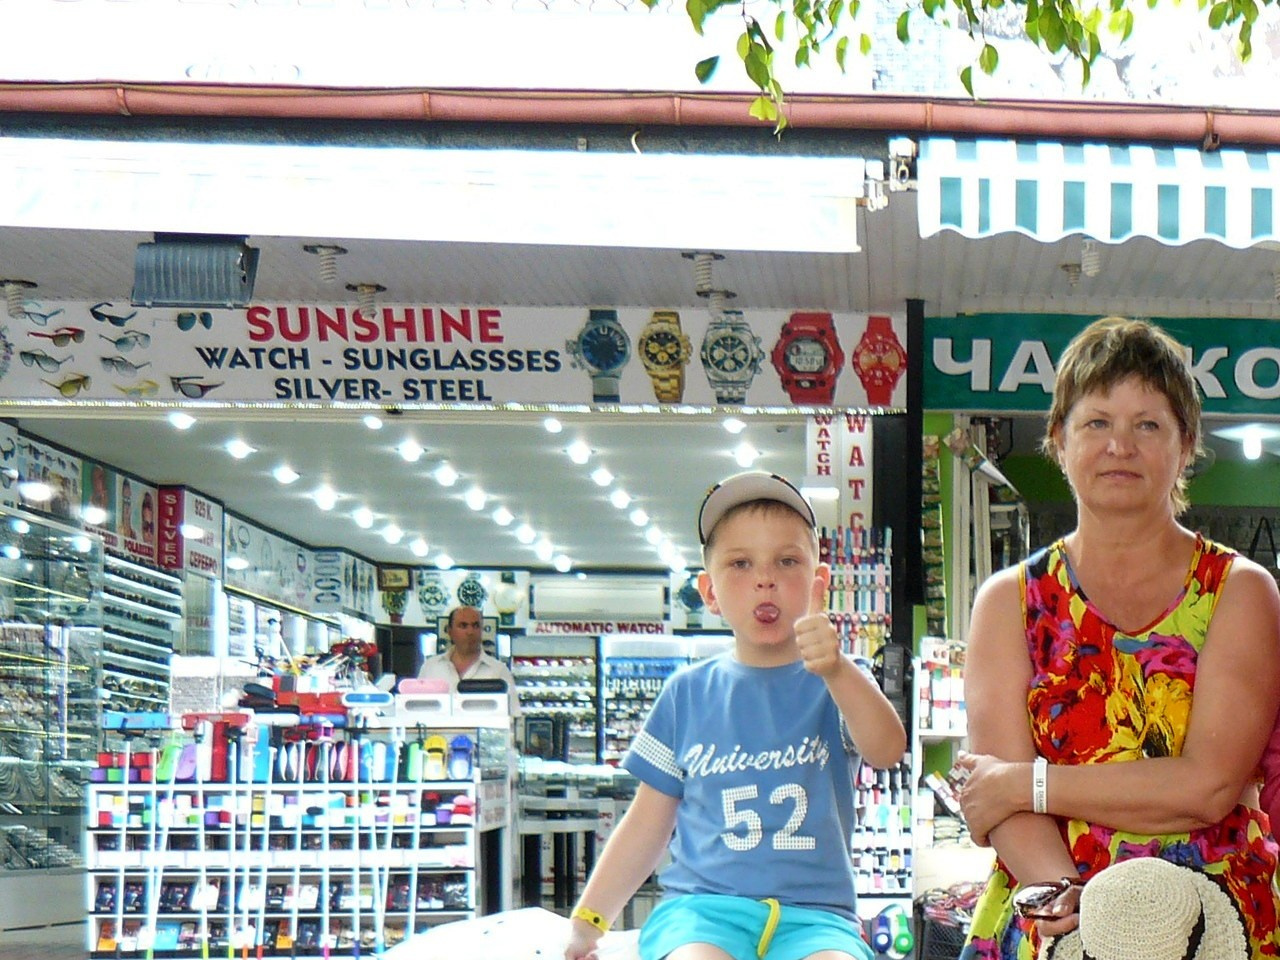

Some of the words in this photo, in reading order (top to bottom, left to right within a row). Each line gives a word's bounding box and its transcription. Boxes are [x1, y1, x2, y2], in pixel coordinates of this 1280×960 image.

[246, 306, 504, 343] SUNSHINE
[196, 347, 310, 370] WATCH
[343, 348, 562, 373] SUNGLASSSES
[932, 337, 1055, 393] ЧА
[403, 378, 492, 401] STEEL
[845, 414, 867, 534] WATC
[164, 493, 178, 566] SILVER
[535, 622, 613, 634] AUTOMATIC
[617, 622, 664, 634] WATCH
[684, 735, 830, 778] University
[720, 783, 816, 851] 52
